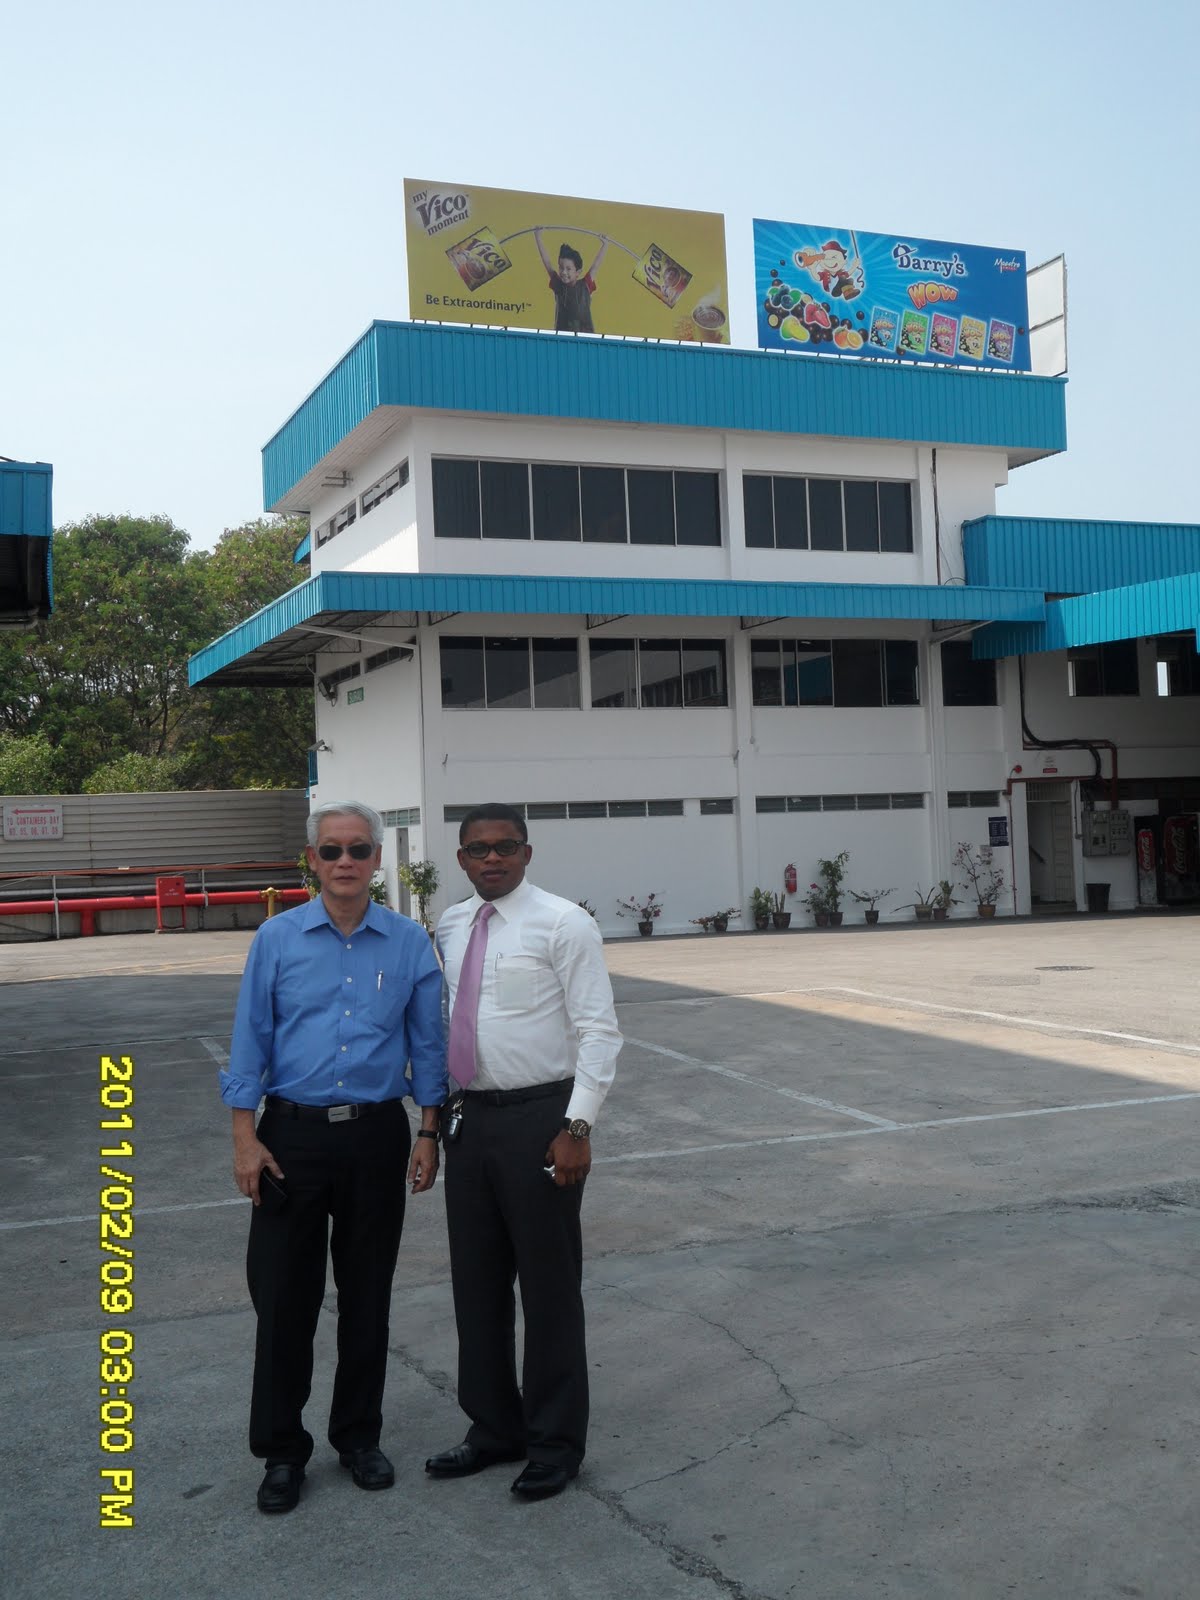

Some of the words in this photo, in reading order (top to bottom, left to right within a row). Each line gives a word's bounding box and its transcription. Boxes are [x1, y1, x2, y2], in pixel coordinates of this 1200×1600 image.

[412, 189, 428, 203] my
[416, 194, 467, 228] Vico
[427, 209, 469, 236] moment
[464, 238, 507, 269] Vico
[897, 253, 966, 277] Darry's
[644, 249, 662, 292] Vico
[426, 294, 440, 305] Be
[907, 281, 959, 310] WOW
